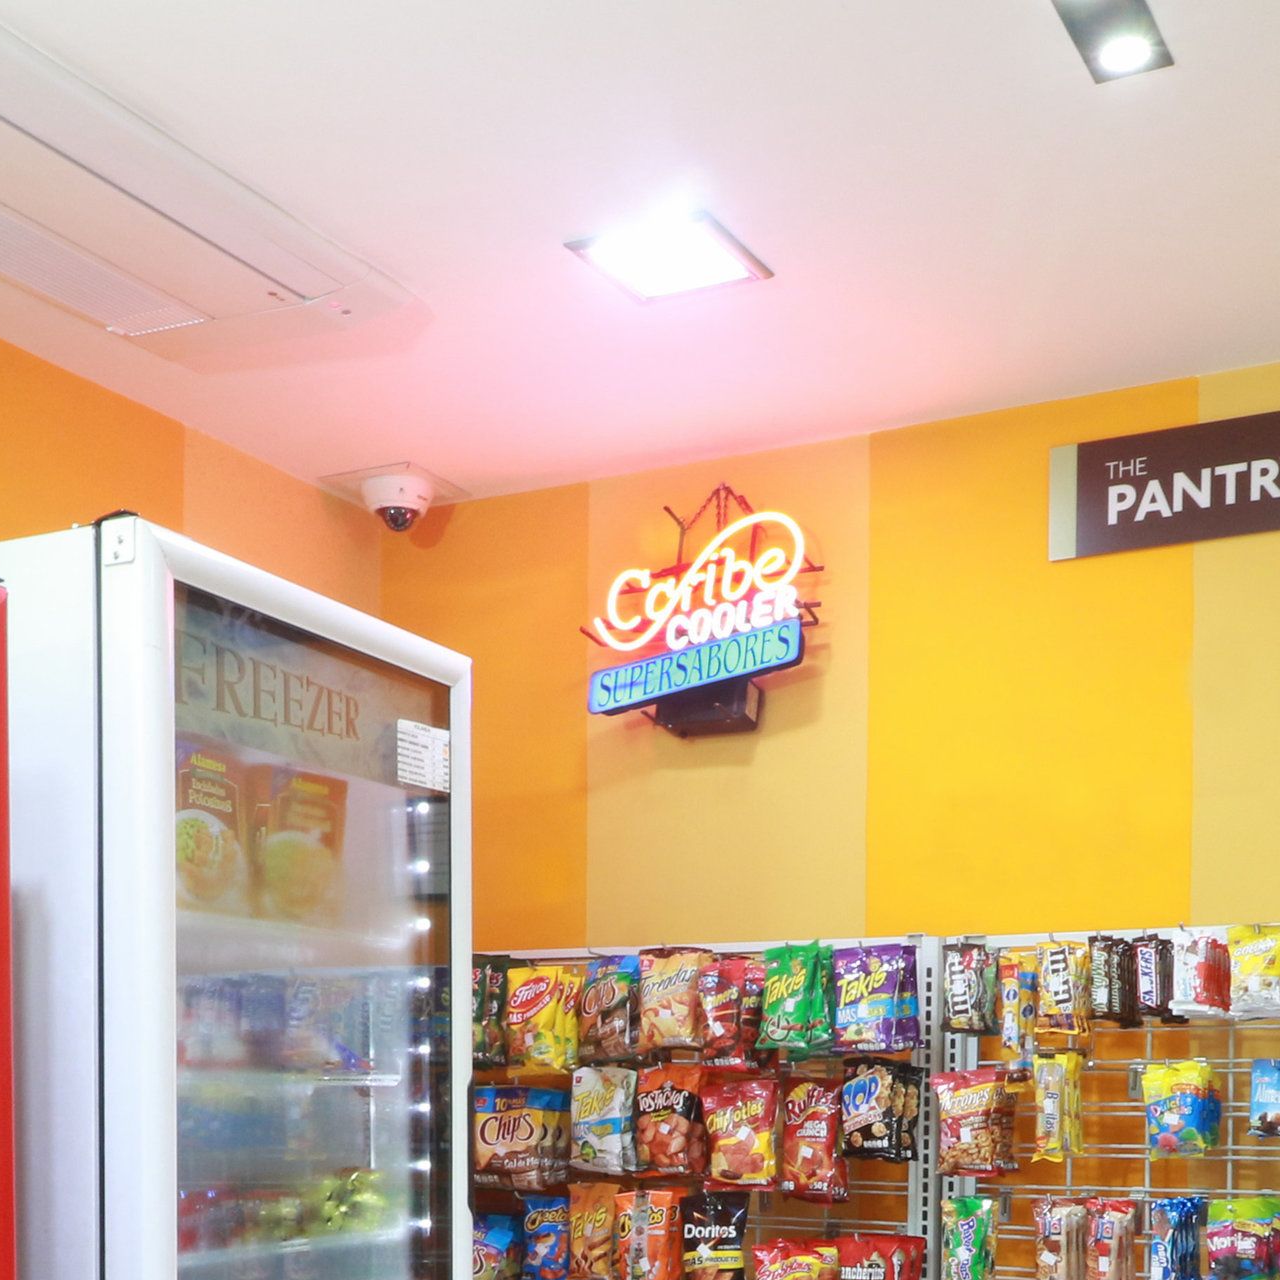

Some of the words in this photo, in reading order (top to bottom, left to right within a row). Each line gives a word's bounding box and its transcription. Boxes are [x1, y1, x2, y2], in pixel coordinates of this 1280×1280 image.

[1105, 457, 1148, 479] THE
[596, 520, 804, 645] Caribe
[666, 583, 800, 651] COOLER
[174, 630, 361, 742] FREEZER
[597, 624, 794, 708] SUPERSABORES
[640, 963, 698, 1000] Toreadas
[764, 968, 808, 1010] Takis
[837, 968, 888, 1008] Takis
[842, 1075, 881, 1119] POP
[524, 1205, 568, 1232] Cheeto
[684, 1223, 737, 1239] Doritos
[840, 1263, 885, 1280] ancheritos
